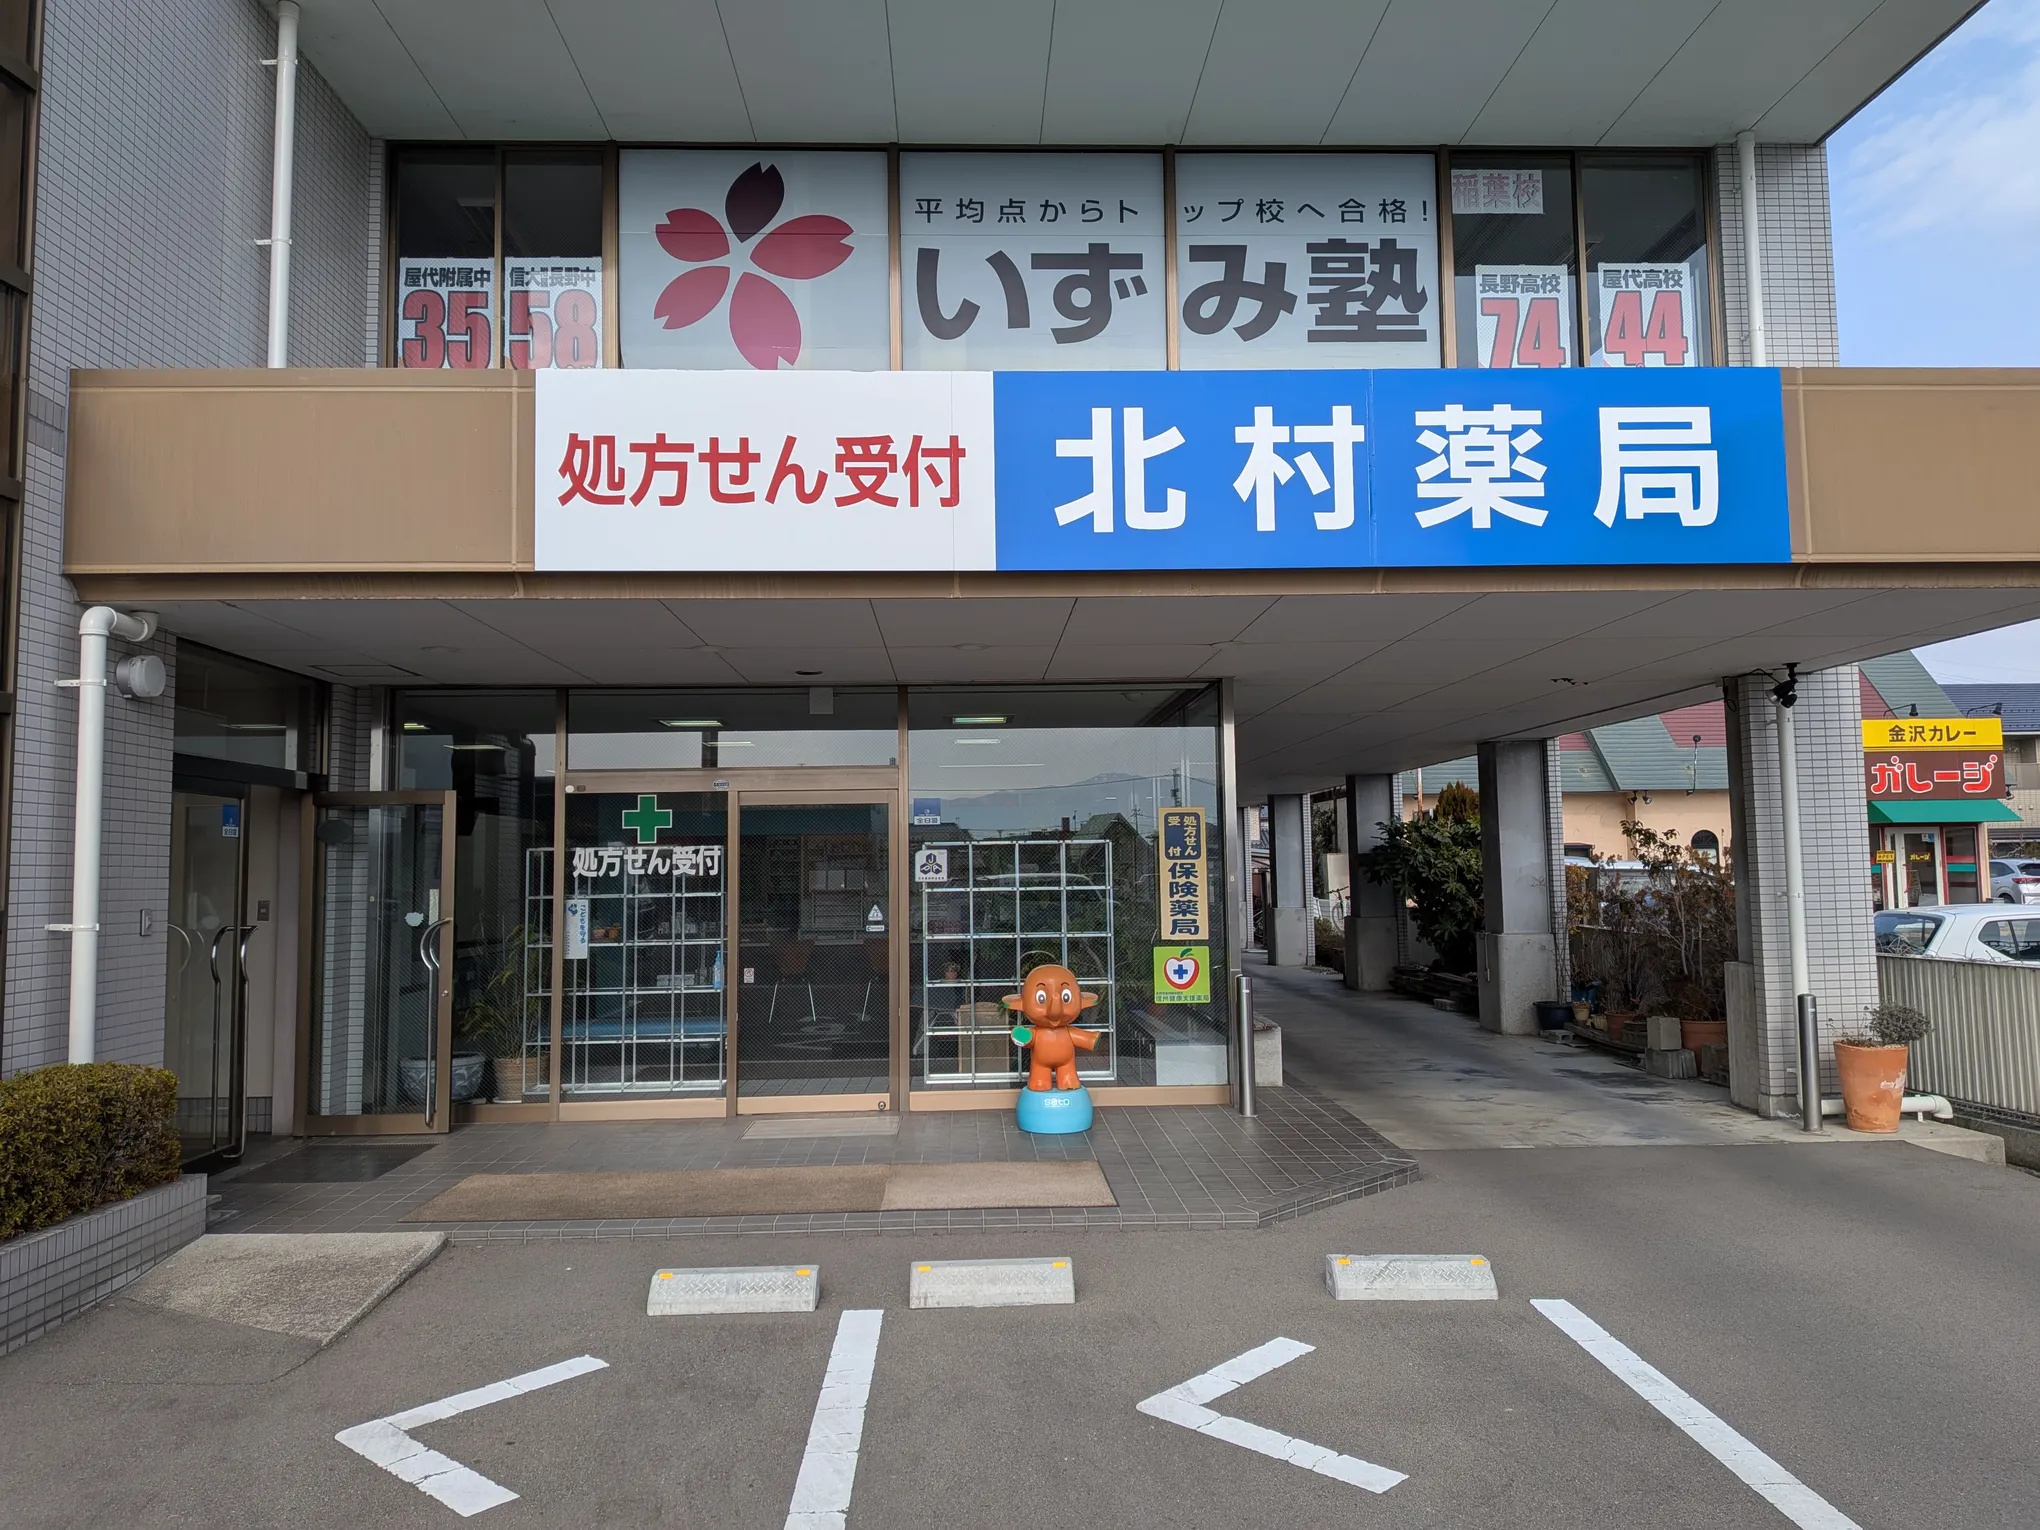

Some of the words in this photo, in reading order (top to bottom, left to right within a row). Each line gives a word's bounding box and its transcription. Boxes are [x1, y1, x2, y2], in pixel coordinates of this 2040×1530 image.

[404, 267, 490, 287] 屋代附属中
[916, 238, 1428, 344] いずみ塾
[1479, 274, 1561, 294] 長野高校
[1602, 269, 1683, 289] 屋代高校
[403, 289, 491, 369] 35
[509, 289, 597, 369] 58
[1481, 298, 1566, 368] 74
[1604, 290, 1689, 366] 44
[558, 433, 967, 508] 処方せん受付
[1053, 403, 1721, 534] 北村薬局
[1889, 724, 1976, 743] 金沢カレー
[1871, 754, 1998, 793] ガレージ
[572, 846, 721, 877] 処方せん受付
[1167, 815, 1182, 857] 受付
[1184, 815, 1198, 857] 処方せん
[1168, 862, 1200, 936] 保険薬局
